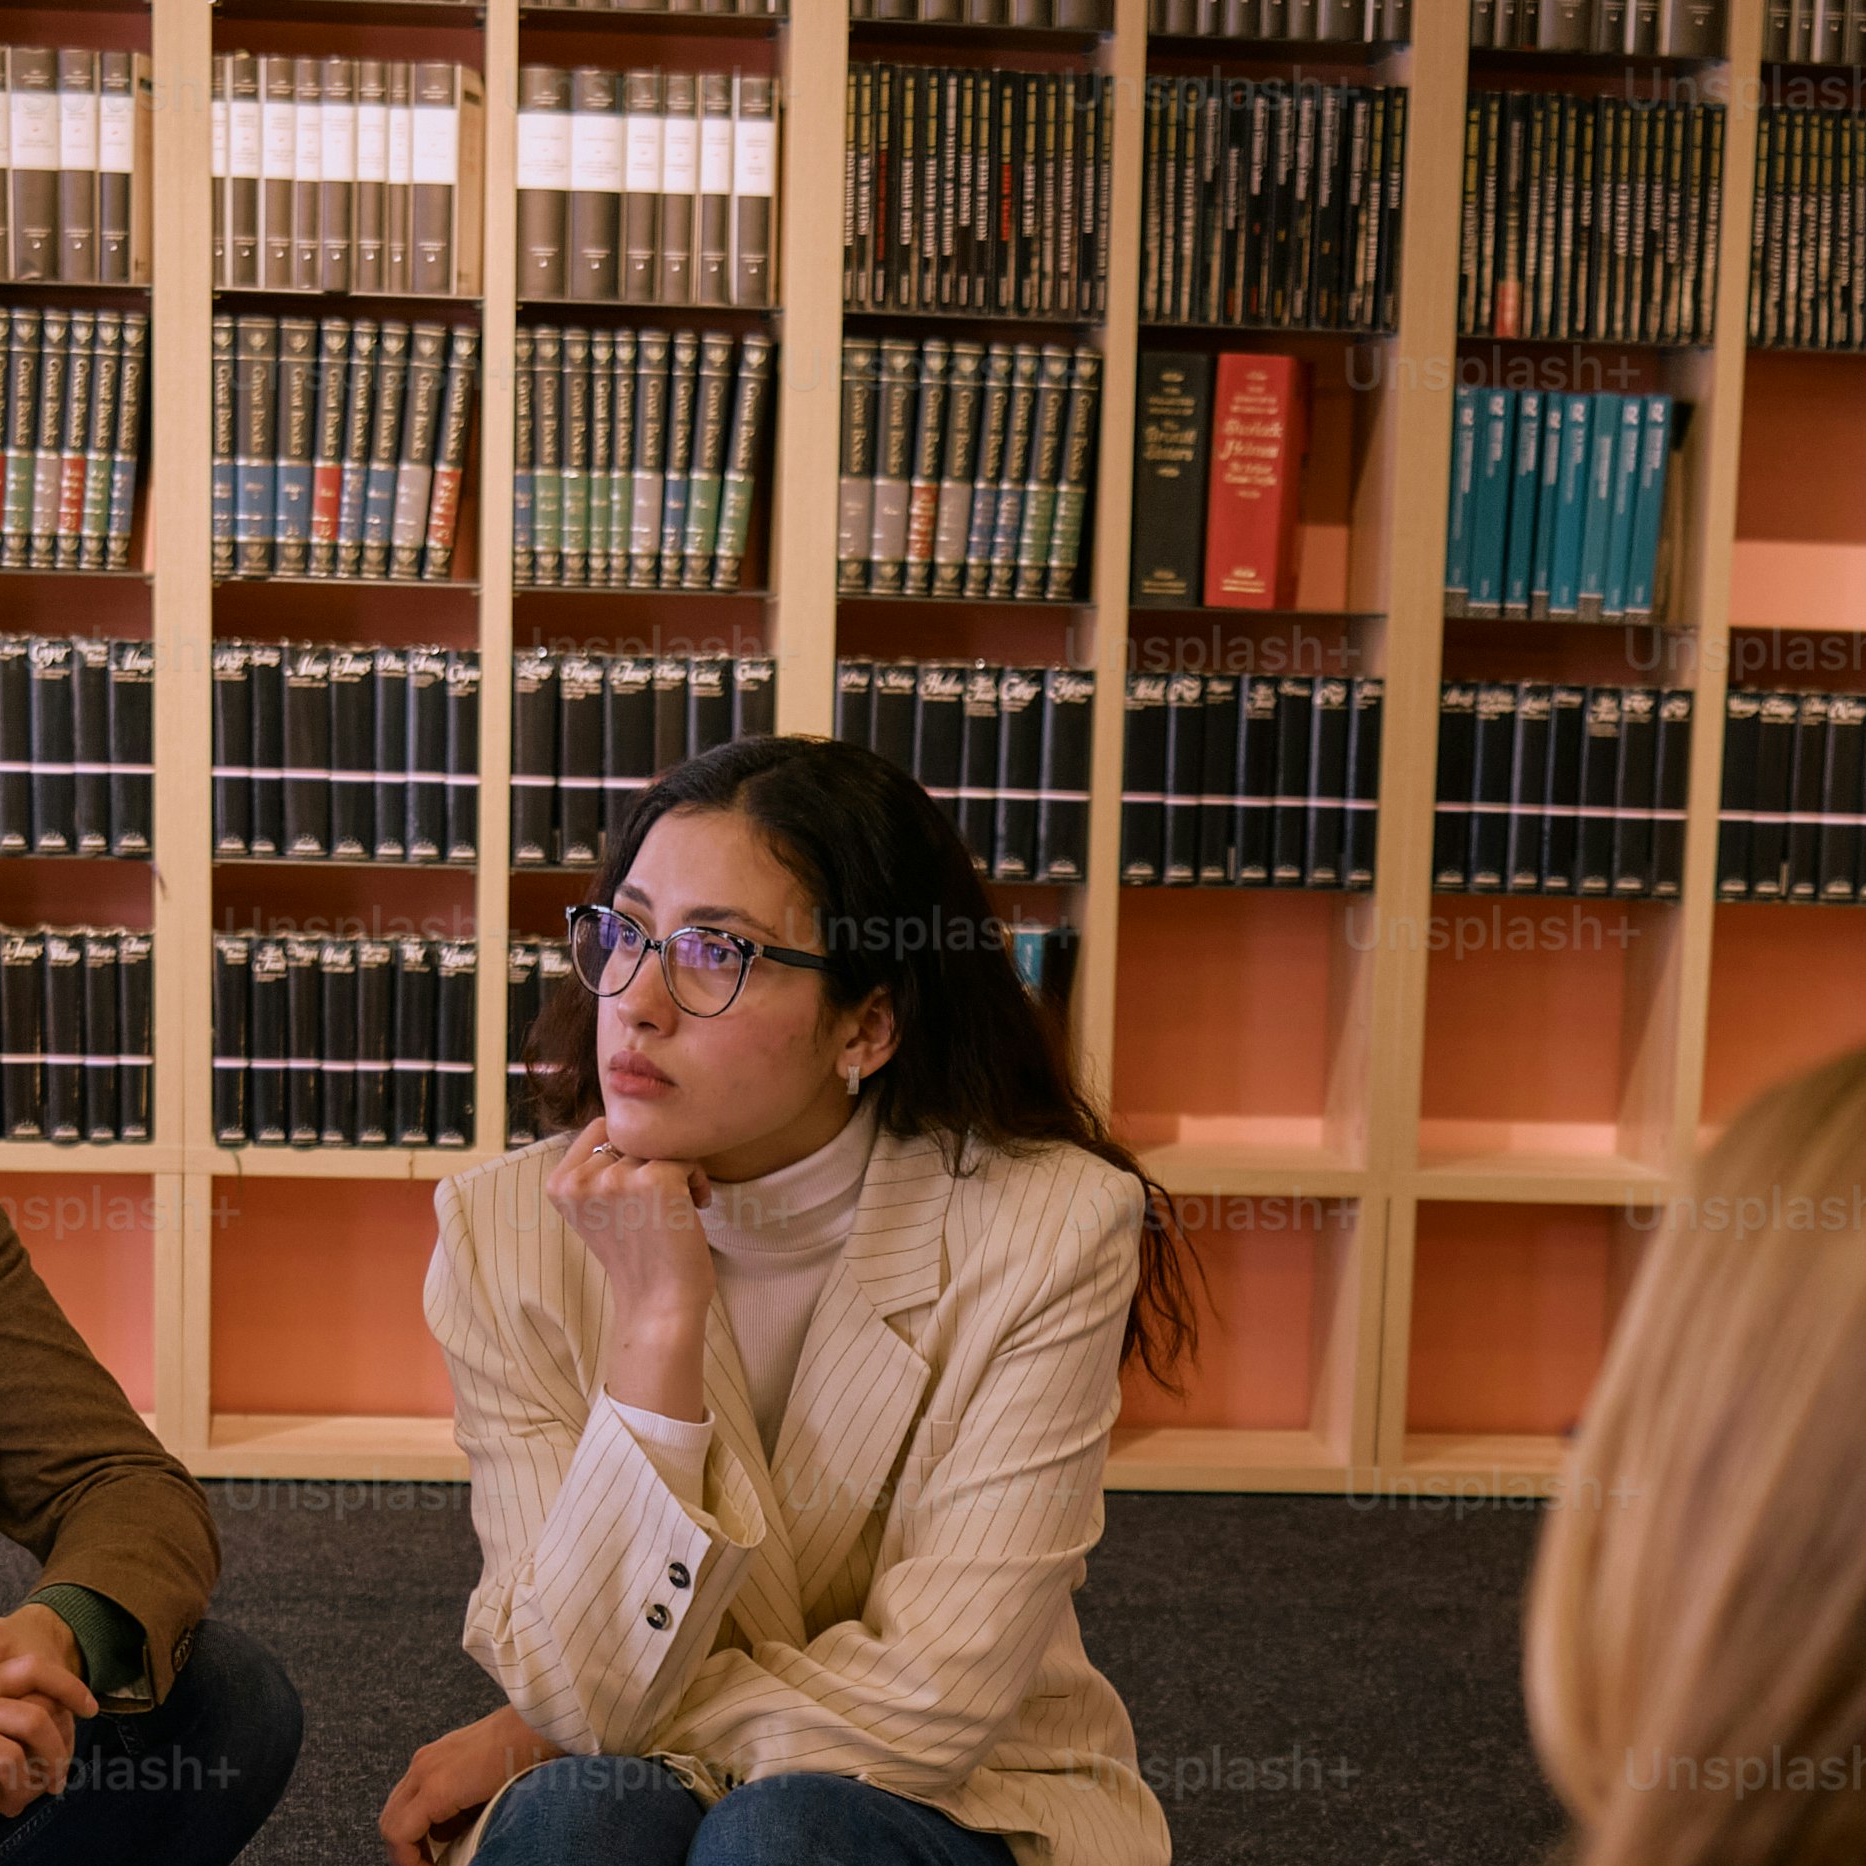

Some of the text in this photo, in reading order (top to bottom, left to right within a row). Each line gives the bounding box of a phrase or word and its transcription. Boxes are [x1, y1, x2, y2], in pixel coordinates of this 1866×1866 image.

[858, 158, 870, 235] WAR WRITING
[901, 161, 913, 245] ENGLISH POETS
[923, 160, 937, 257] THEATRE HISTORY
[942, 136, 955, 256] SCIENCE AND RELIGION
[959, 155, 972, 226] JOHN DONNE
[976, 157, 989, 240] CRIME FICTION
[1023, 166, 1036, 237] GREEK LYRIC
[1061, 159, 1073, 272] CANADIAN LITERATURE
[1083, 166, 1094, 233] WORDSWORTH
[1614, 183, 1629, 256] CHEKHOV
